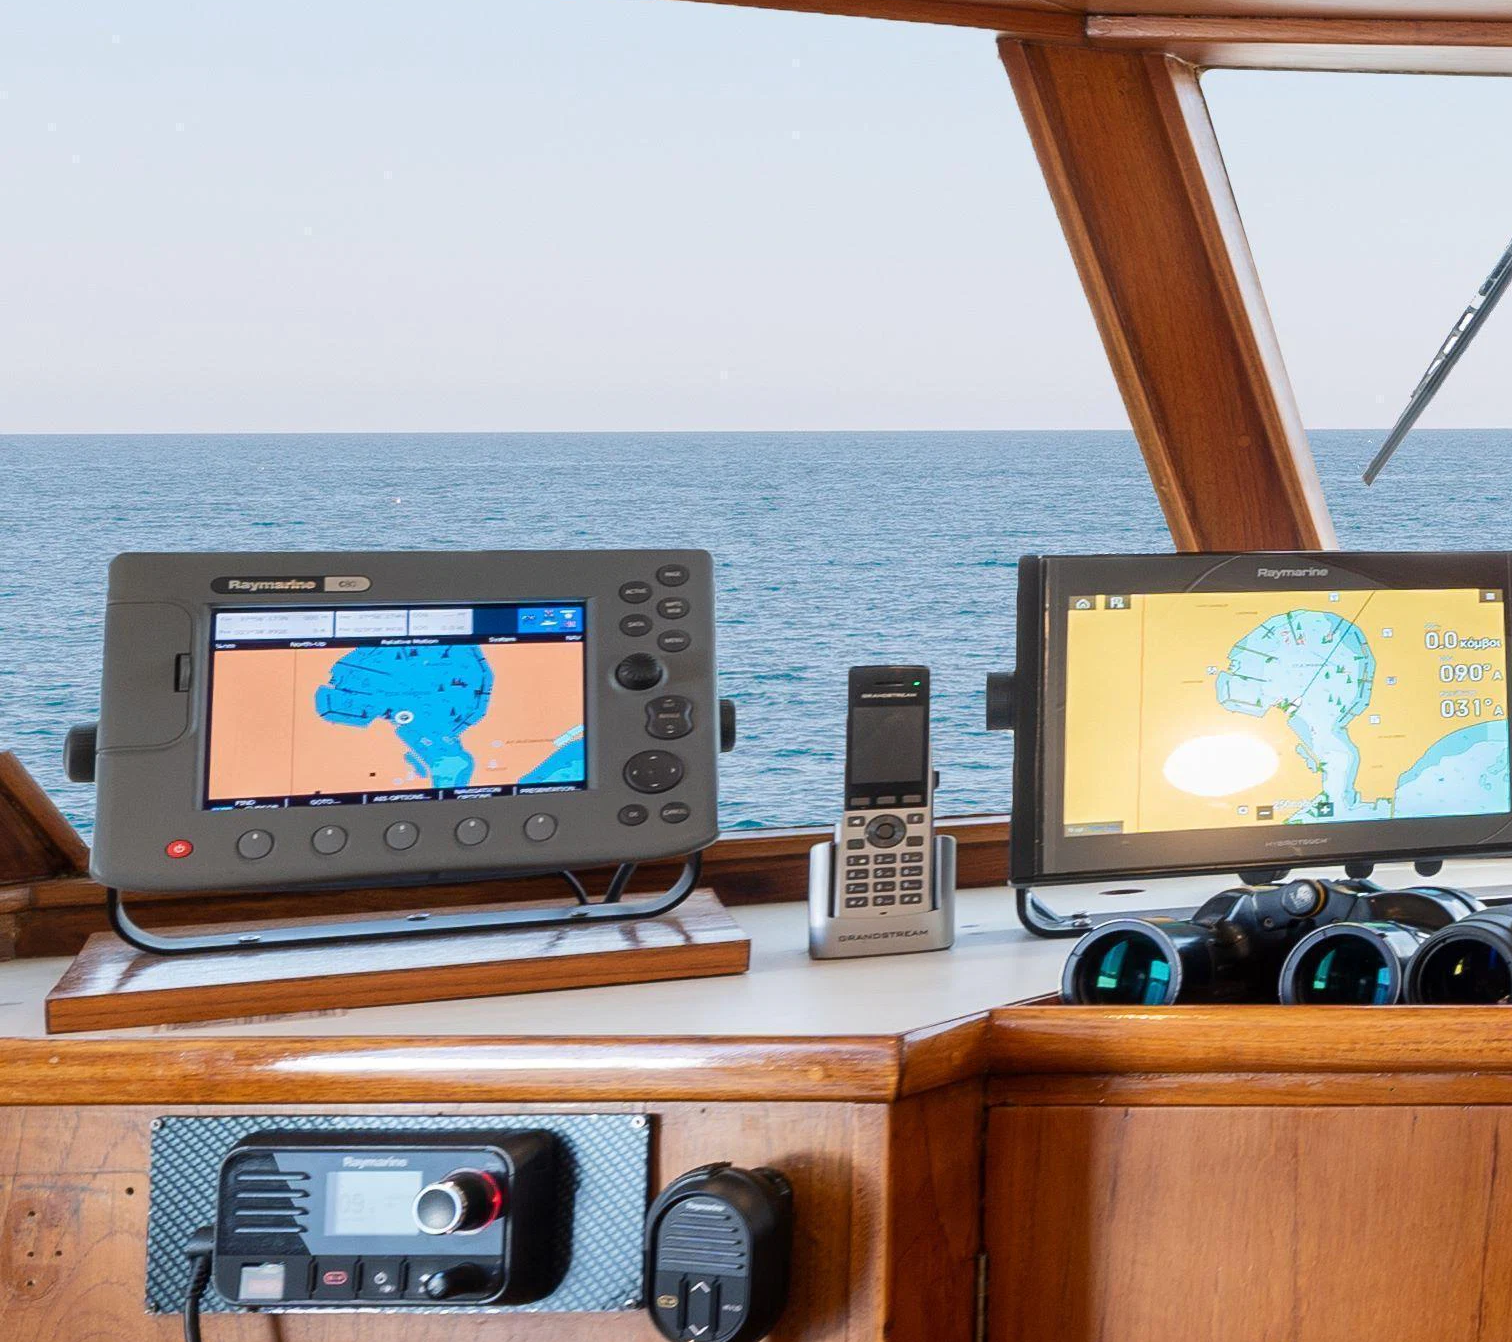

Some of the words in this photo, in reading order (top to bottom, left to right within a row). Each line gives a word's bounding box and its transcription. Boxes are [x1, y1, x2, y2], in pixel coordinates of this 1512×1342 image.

[1257, 567, 1329, 580] Raymarine
[228, 579, 317, 592] Raymarine
[1424, 630, 1459, 650] 0.0
[838, 929, 929, 942] GRANDSTREAM
[343, 1156, 408, 1170] Raymarine
